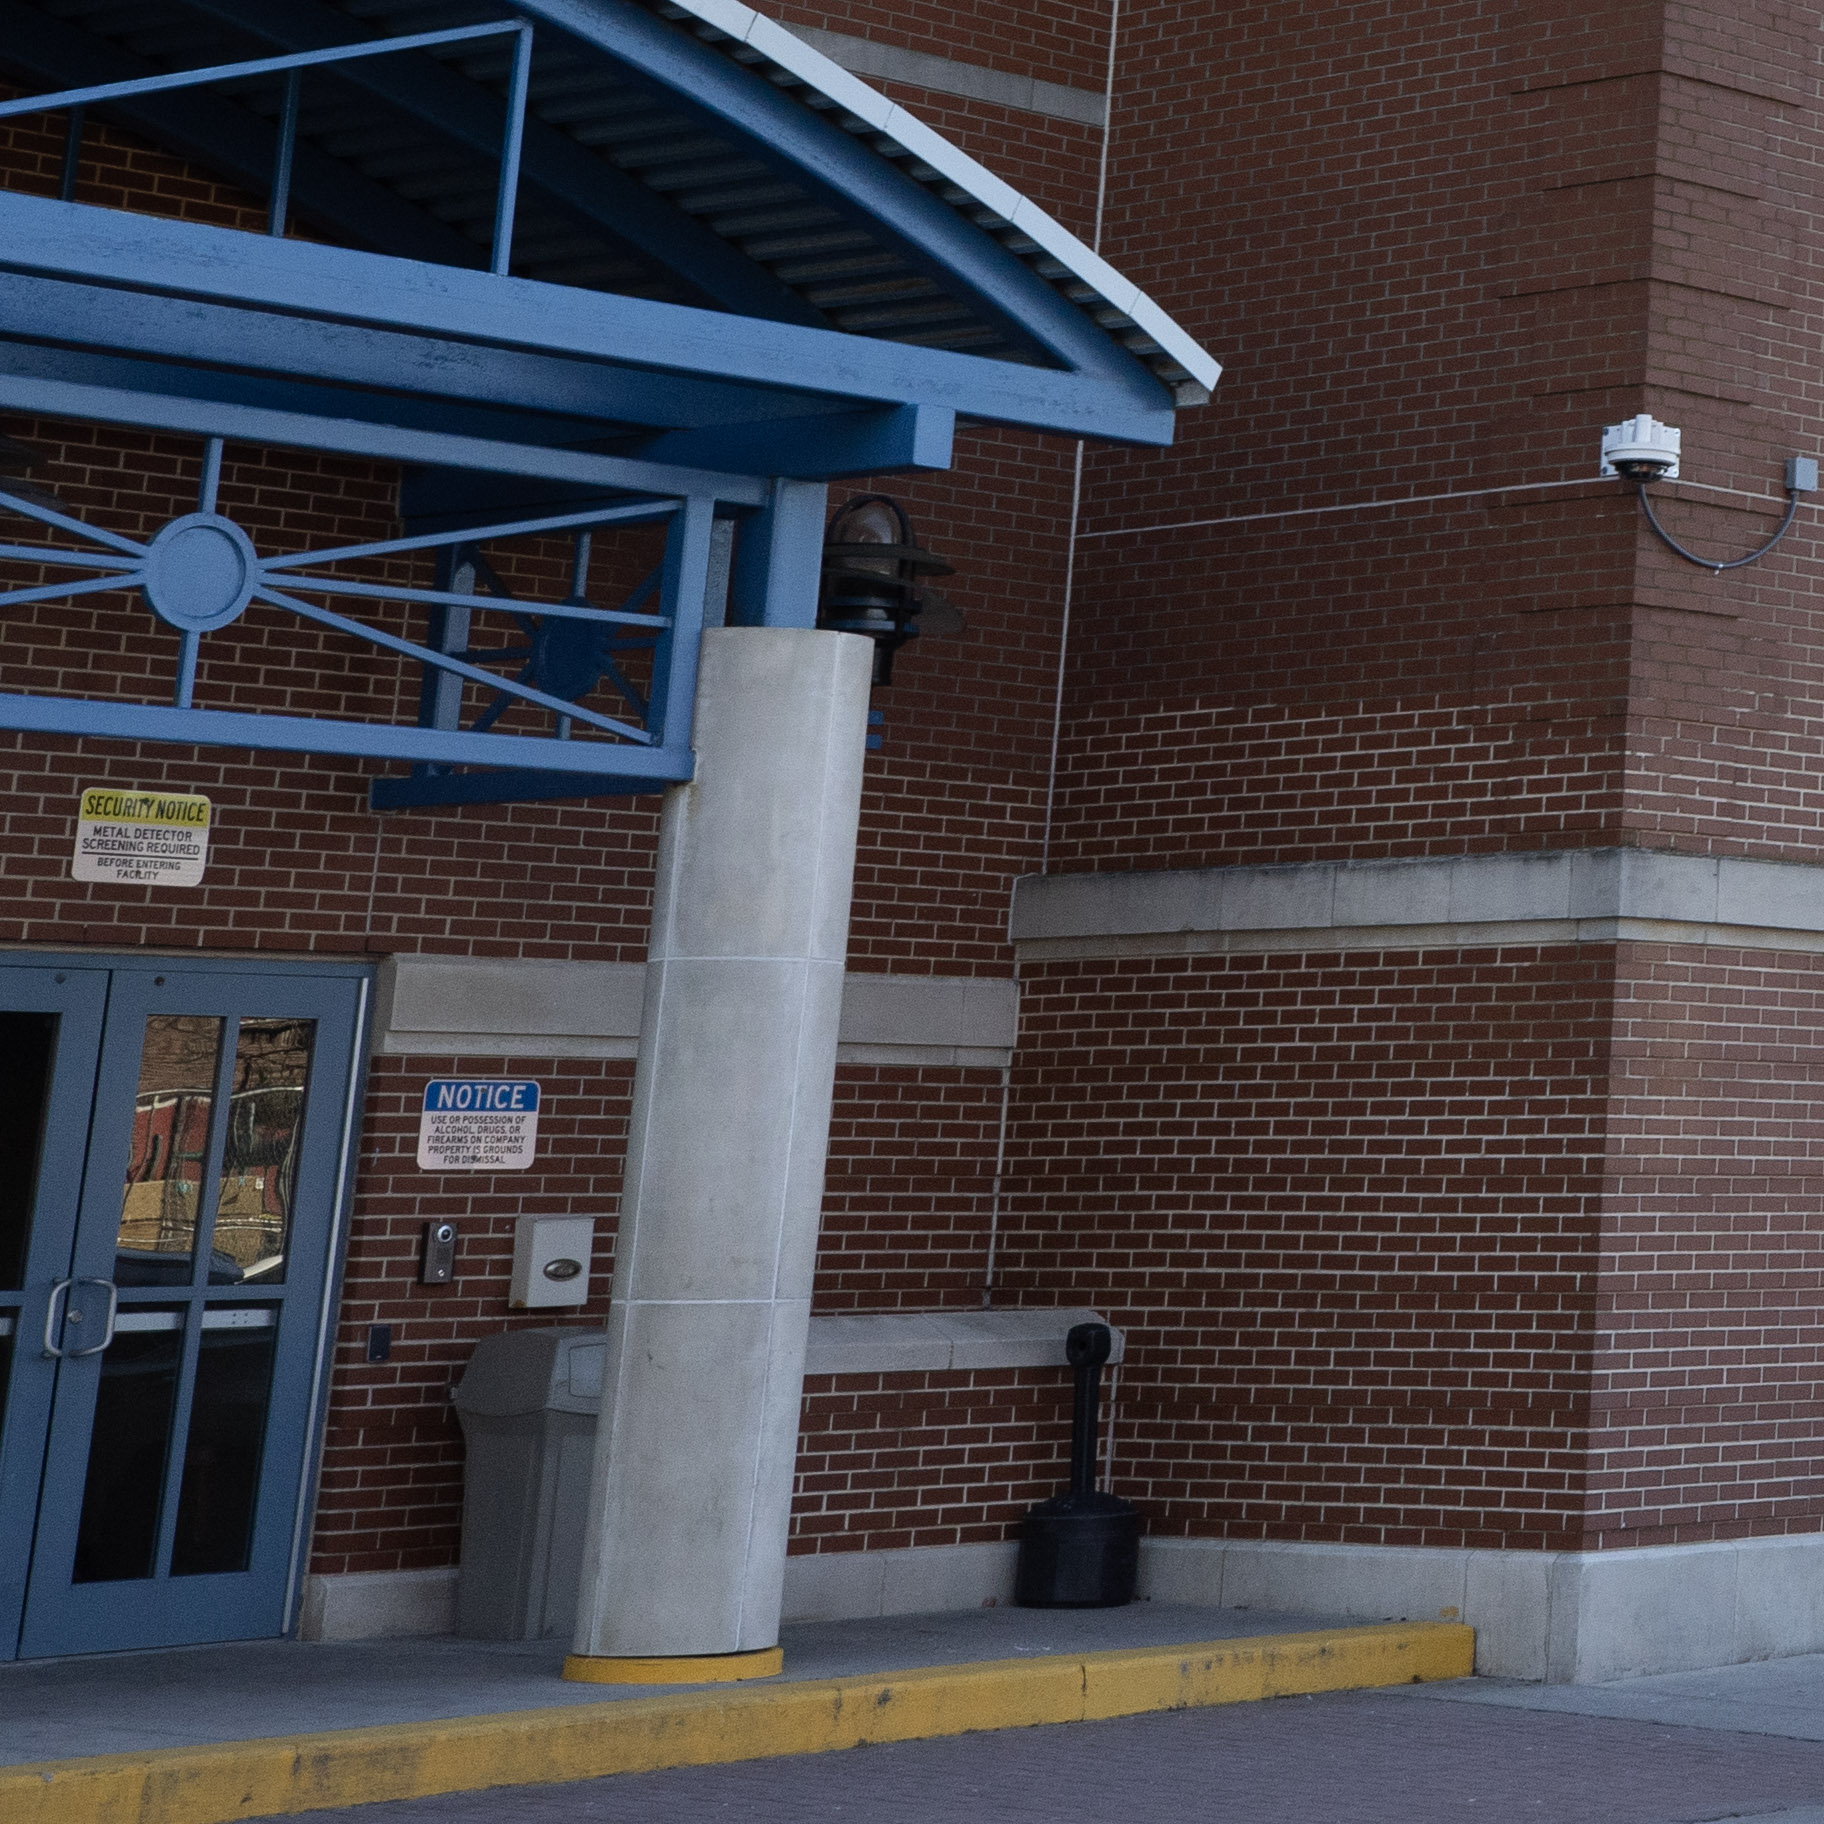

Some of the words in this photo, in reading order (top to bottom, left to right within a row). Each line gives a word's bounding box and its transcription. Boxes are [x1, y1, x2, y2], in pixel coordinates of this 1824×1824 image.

[86, 795, 155, 818] SECURITY
[155, 799, 206, 822] NOTICE
[93, 825, 130, 839] METAL
[134, 828, 192, 842] DETECTOR
[82, 838, 144, 852] SCREENING
[146, 842, 200, 855] REQUIRED
[97, 857, 134, 868] BEFORE
[136, 860, 181, 870] ENTERING
[116, 869, 160, 880] FACILITY
[436, 1084, 527, 1109] NOTICE
[431, 1116, 447, 1124] USE
[449, 1116, 460, 1124] OR
[462, 1116, 513, 1124] POSSESSION
[515, 1116, 526, 1124] OF
[509, 1126, 521, 1134] OR
[427, 1136, 468, 1144] FIREARMS
[470, 1136, 481, 1144] ON
[484, 1136, 526, 1144] COMPANY
[428, 1146, 472, 1154] PROPERTY
[473, 1146, 480, 1154] IS
[483, 1146, 523, 1154] GROUNDS
[443, 1156, 460, 1164] FOR
